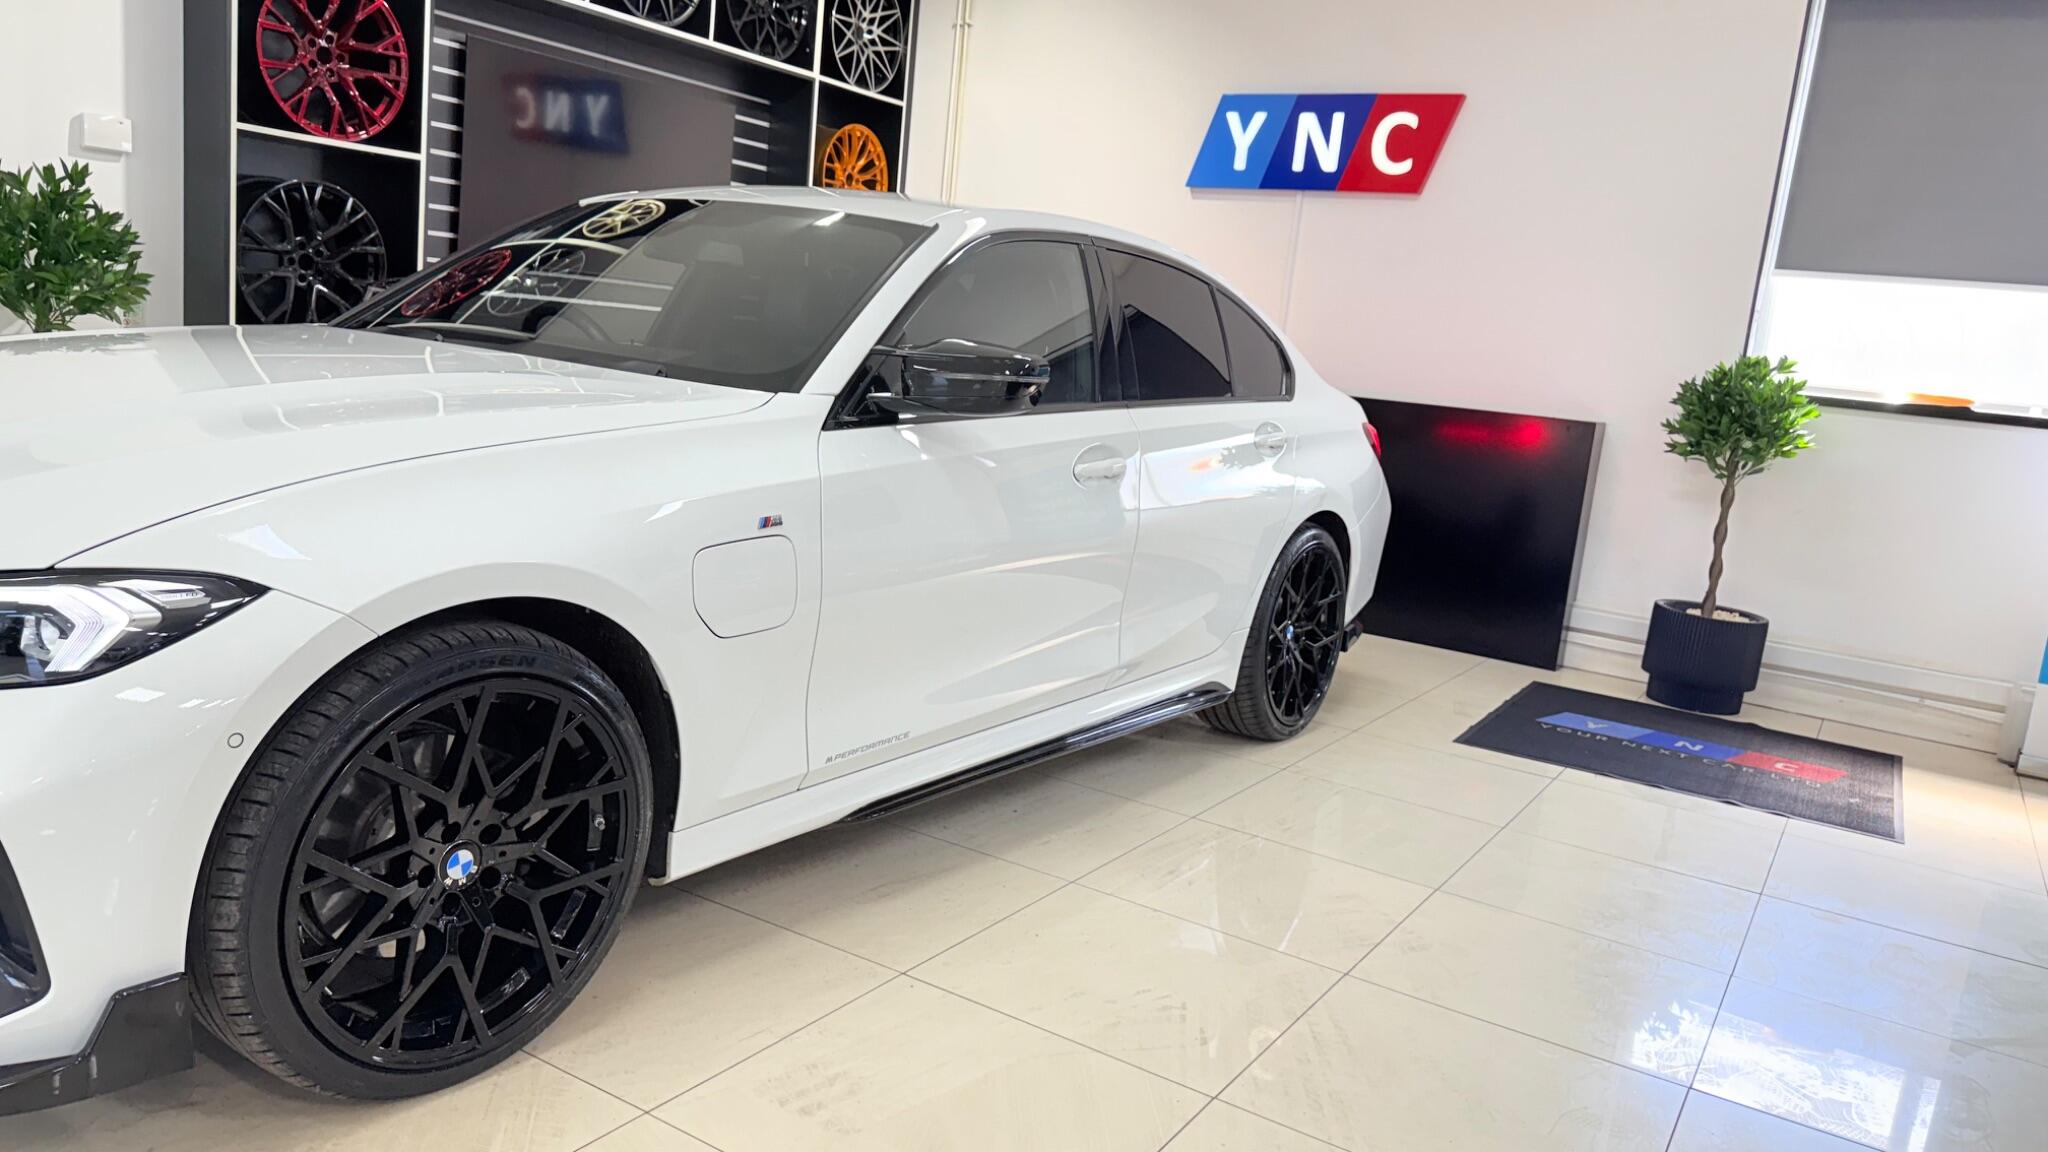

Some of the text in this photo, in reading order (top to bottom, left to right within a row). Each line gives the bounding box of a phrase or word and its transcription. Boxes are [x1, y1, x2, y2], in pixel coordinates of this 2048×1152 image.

[1225, 111, 1419, 175] YNC
[1540, 723, 1608, 742] YOUR
[1622, 740, 1689, 759] NEXT
[1702, 758, 1755, 773] CAR
